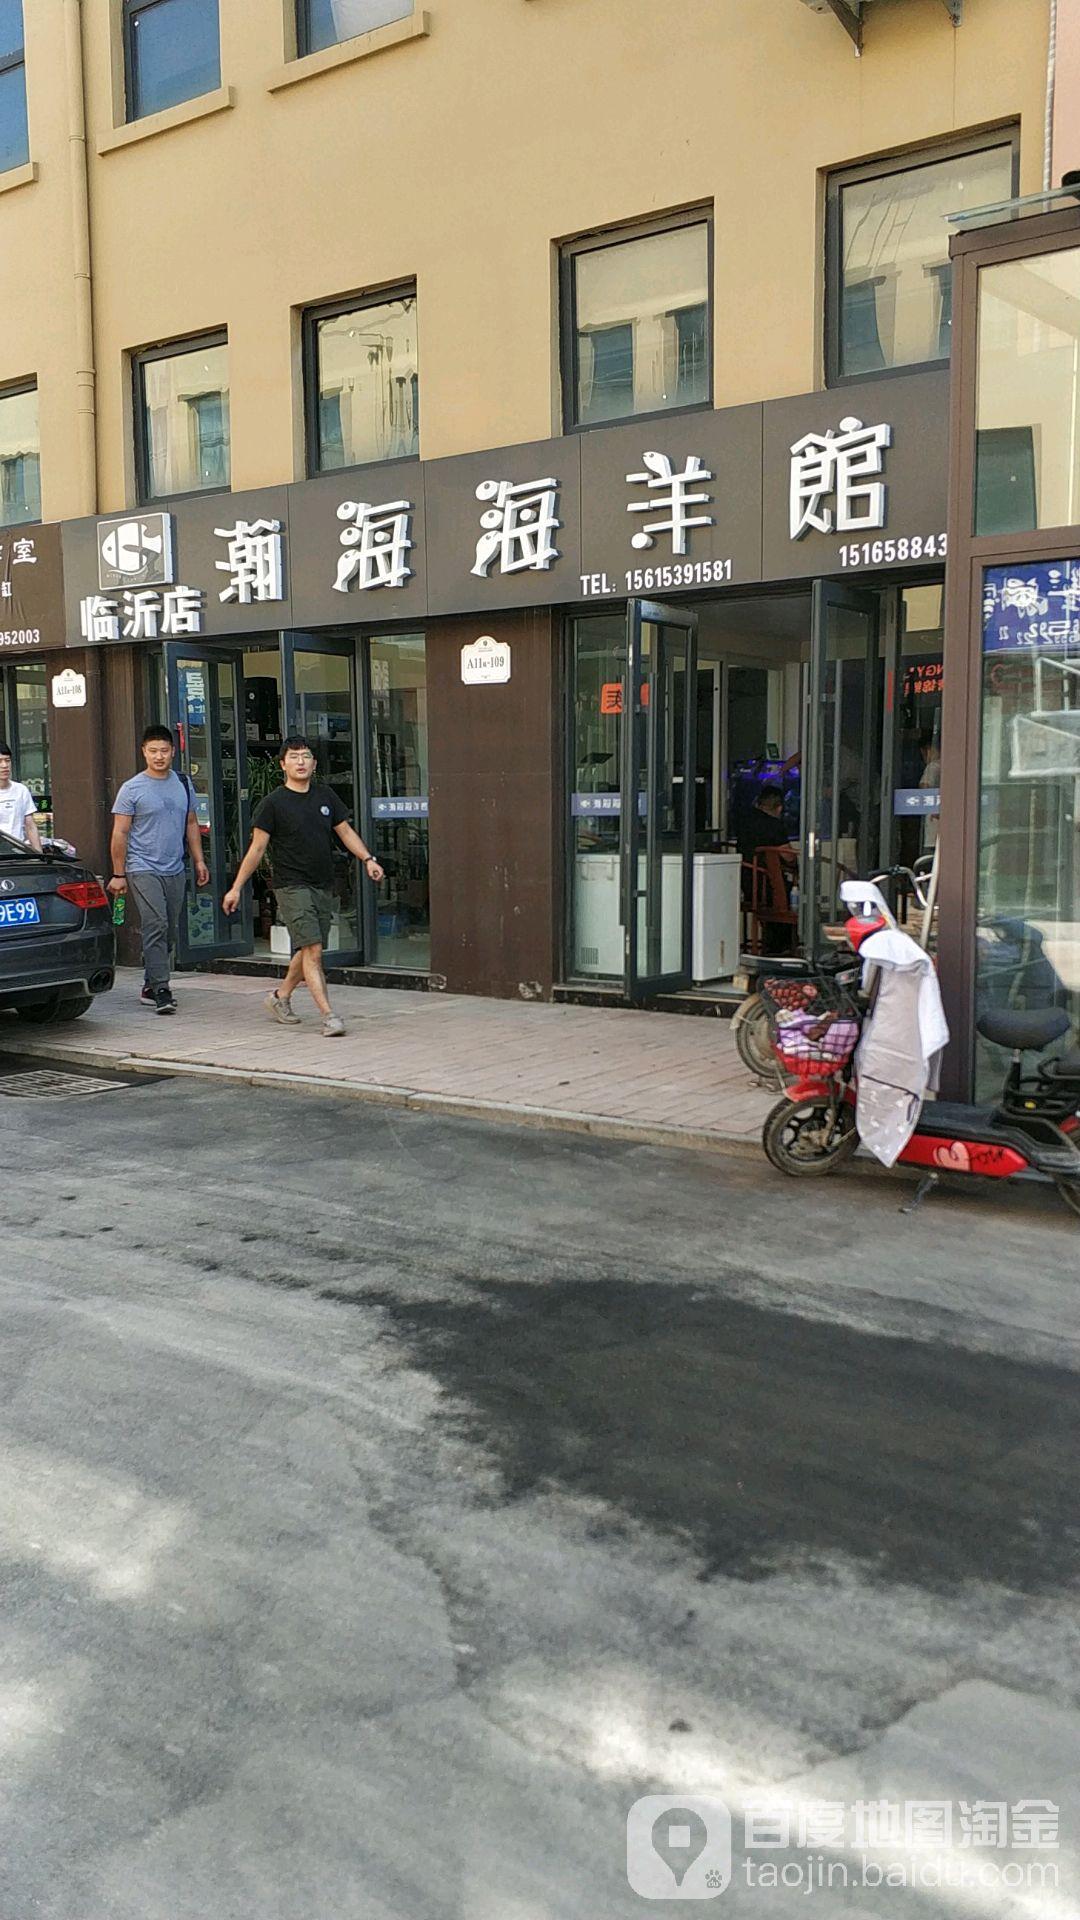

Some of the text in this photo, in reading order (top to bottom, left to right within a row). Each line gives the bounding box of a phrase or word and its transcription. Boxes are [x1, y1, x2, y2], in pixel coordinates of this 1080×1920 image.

[839, 532, 948, 567] 151658843
[625, 558, 732, 591] 15615391581
[80, 585, 202, 642] 临沂店
